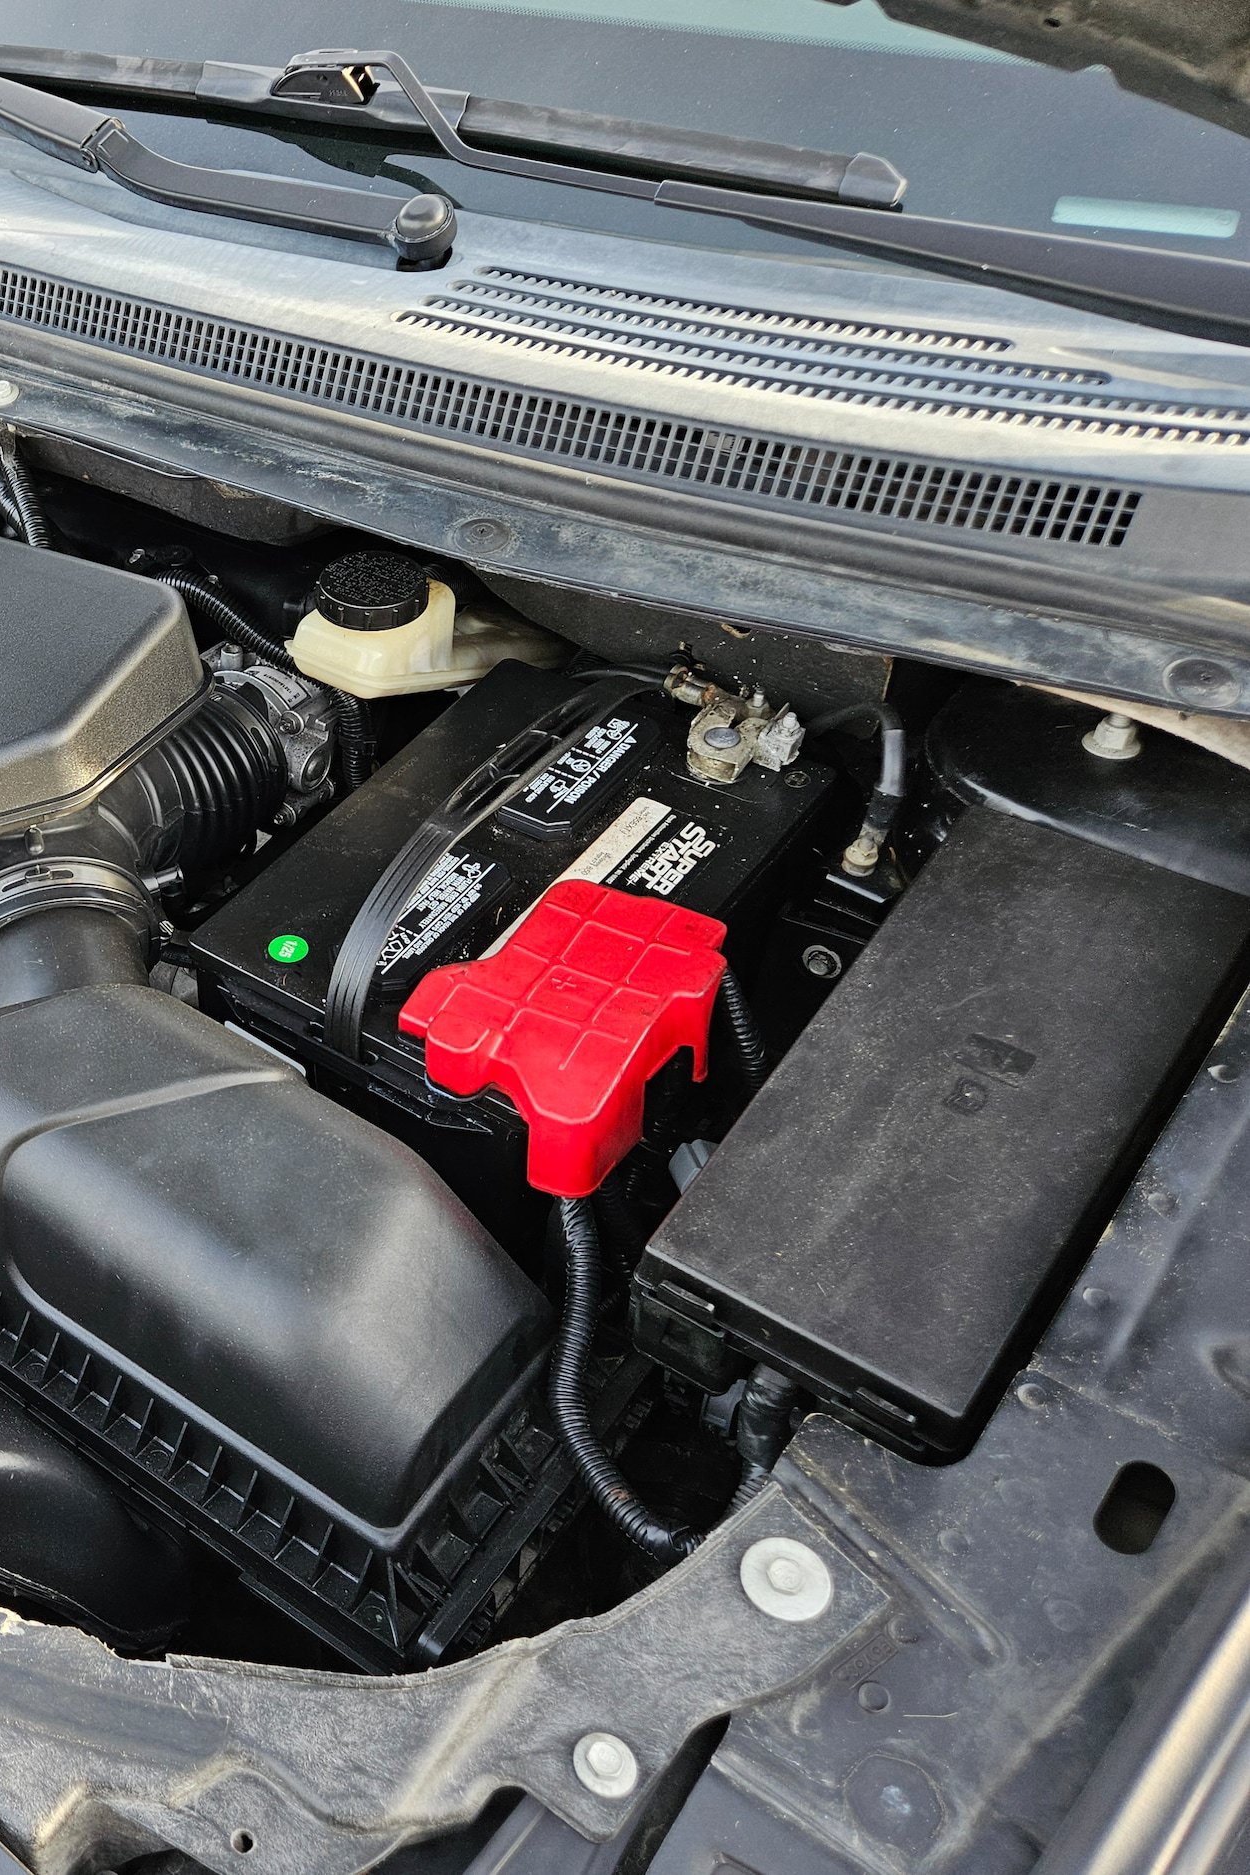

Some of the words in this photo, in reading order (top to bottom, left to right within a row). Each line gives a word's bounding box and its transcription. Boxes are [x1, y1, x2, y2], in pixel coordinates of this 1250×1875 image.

[596, 742, 630, 772] DANGER
[564, 776, 597, 804] POISON
[645, 821, 706, 890] START
[653, 839, 716, 896] SUPER
